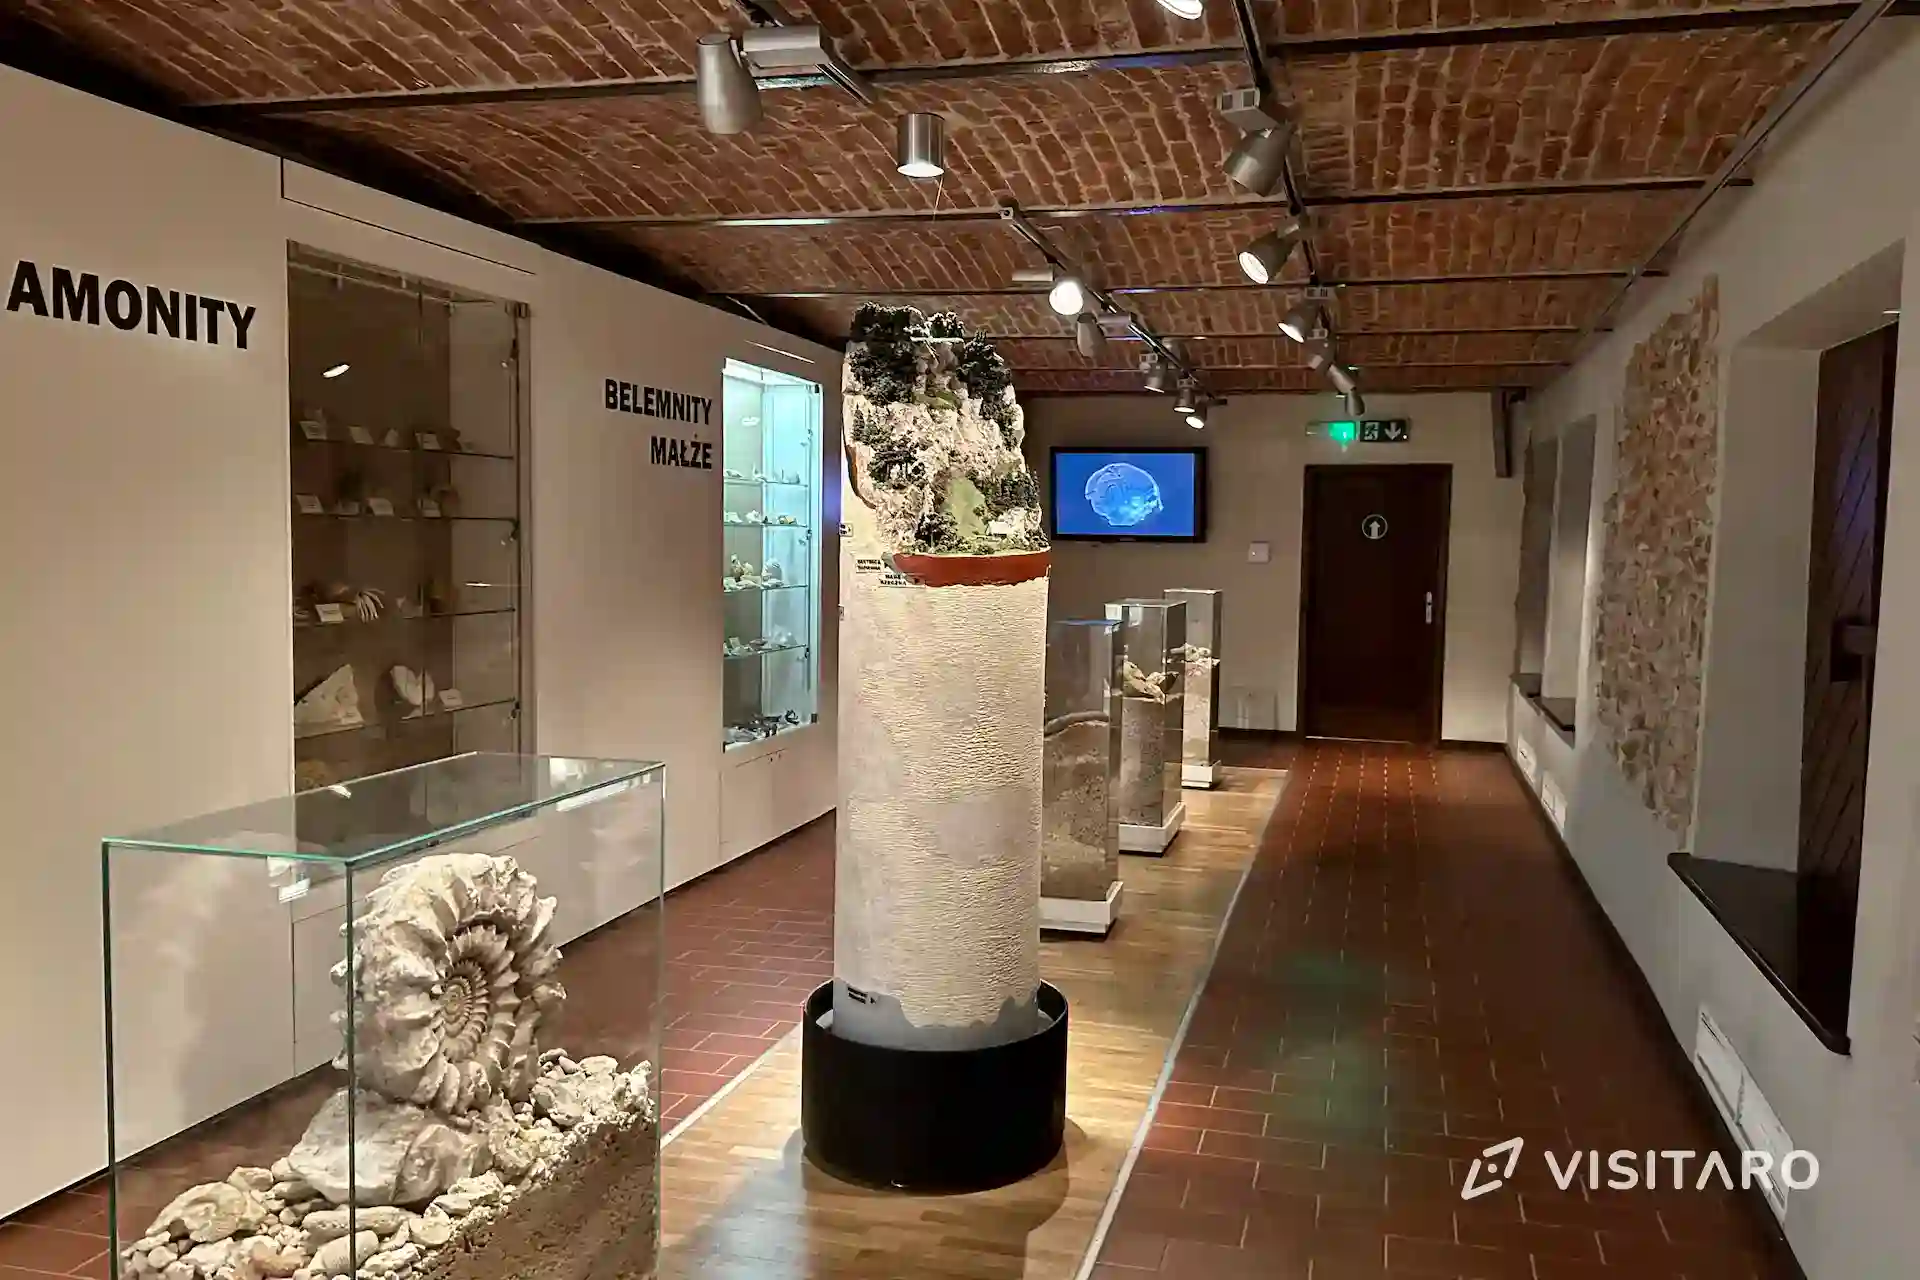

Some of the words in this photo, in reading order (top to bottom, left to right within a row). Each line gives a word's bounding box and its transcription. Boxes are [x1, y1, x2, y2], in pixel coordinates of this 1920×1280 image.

[6, 259, 257, 350] AMONITY
[605, 378, 713, 425] BELEMNITY
[650, 433, 713, 470] MAŁŻE
